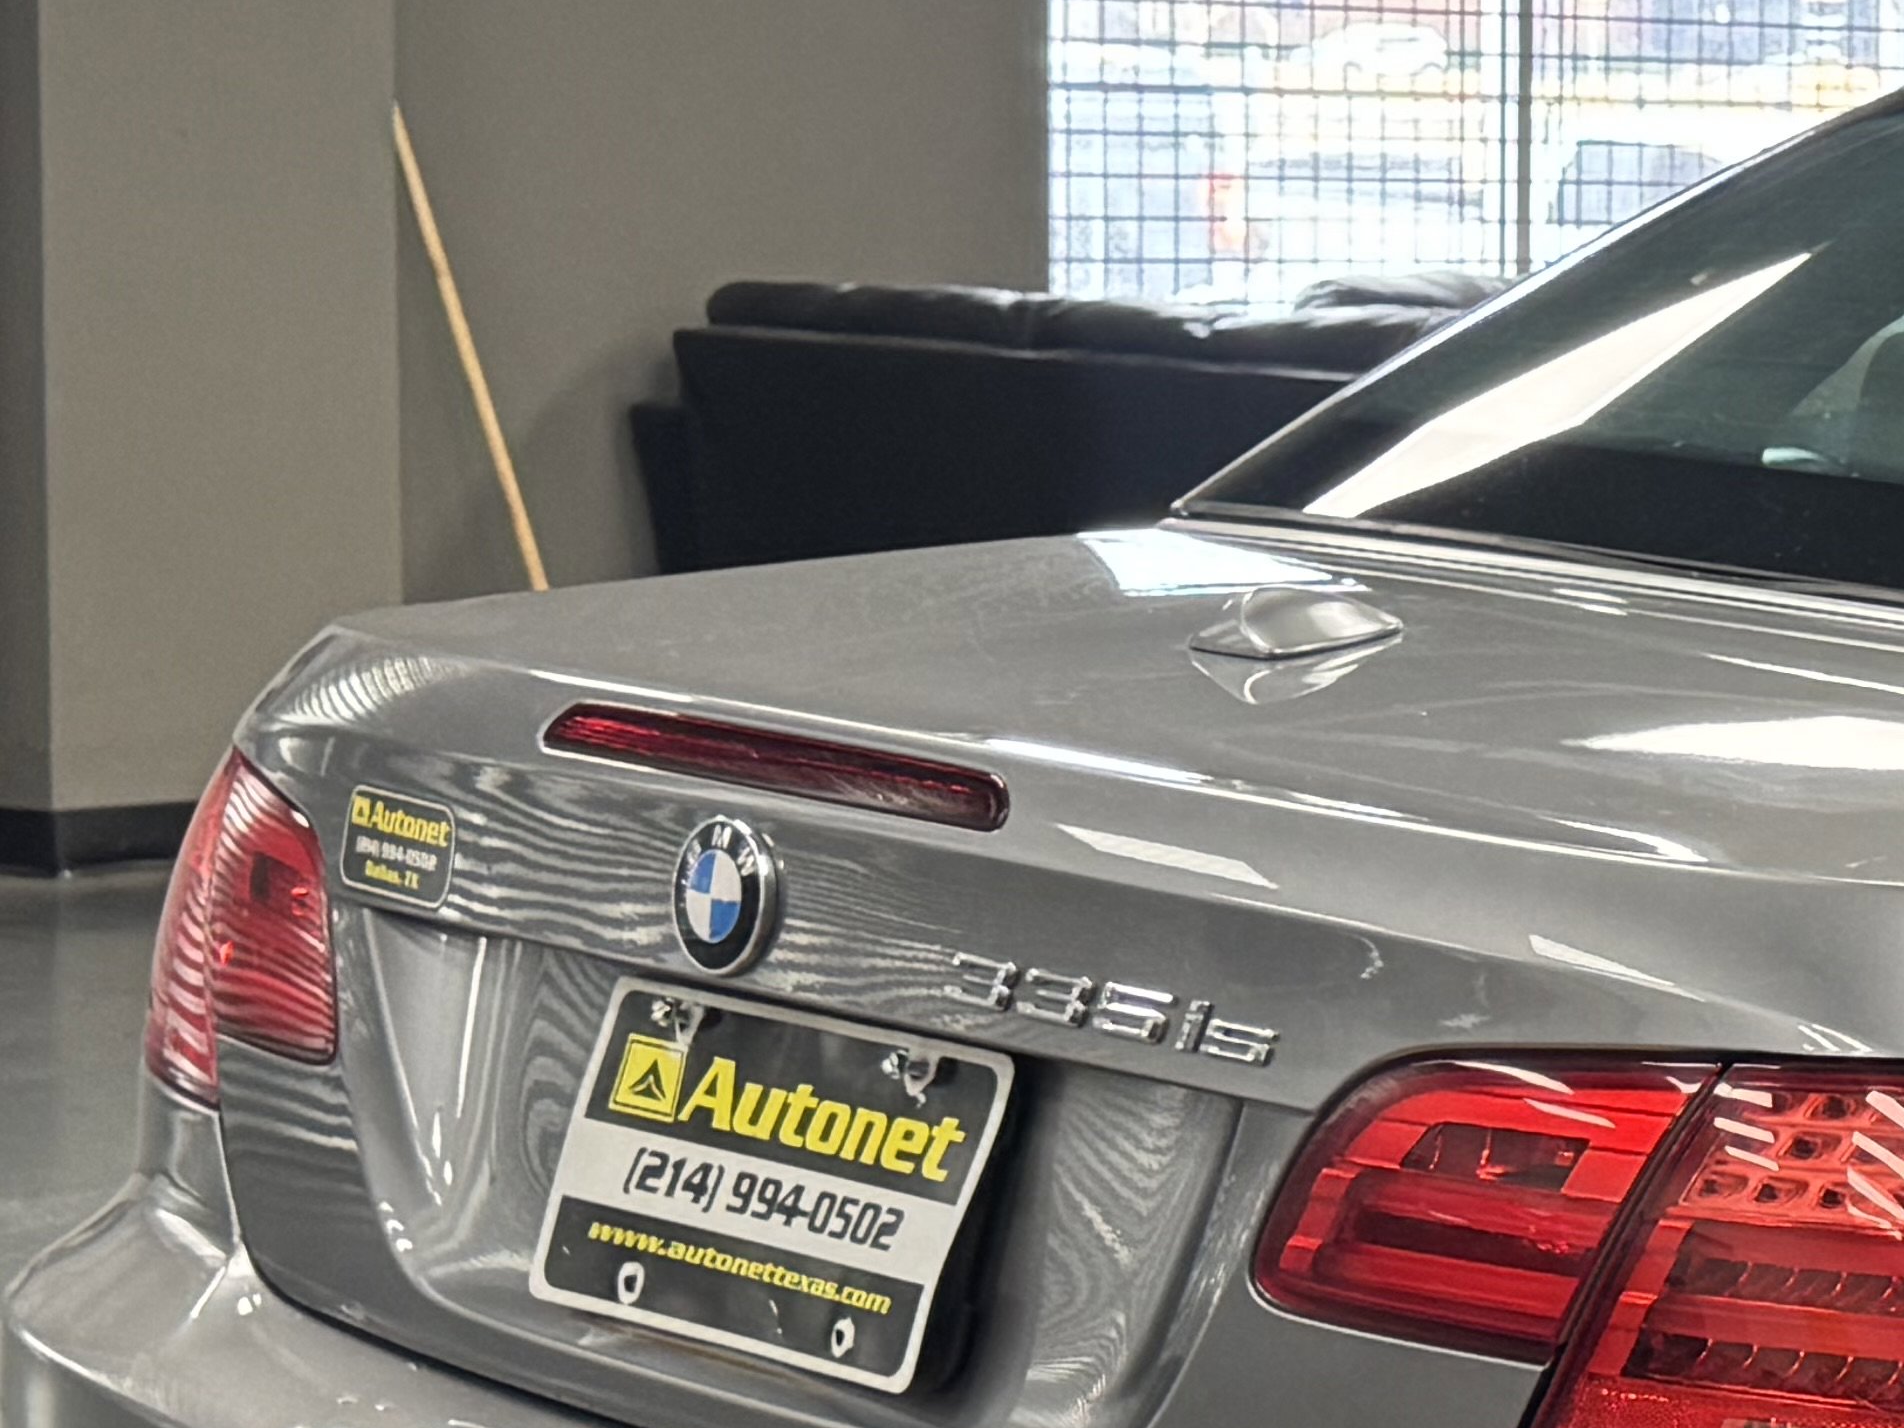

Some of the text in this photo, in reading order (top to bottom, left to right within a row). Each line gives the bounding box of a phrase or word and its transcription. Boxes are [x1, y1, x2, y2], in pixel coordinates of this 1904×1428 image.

[370, 801, 450, 847] Autonet
[944, 951, 1280, 1067] 335is
[677, 1057, 965, 1182] Autonet
[623, 1147, 905, 1252] (214) 994-0502
[587, 1221, 892, 1315] www.autonettexas.com
